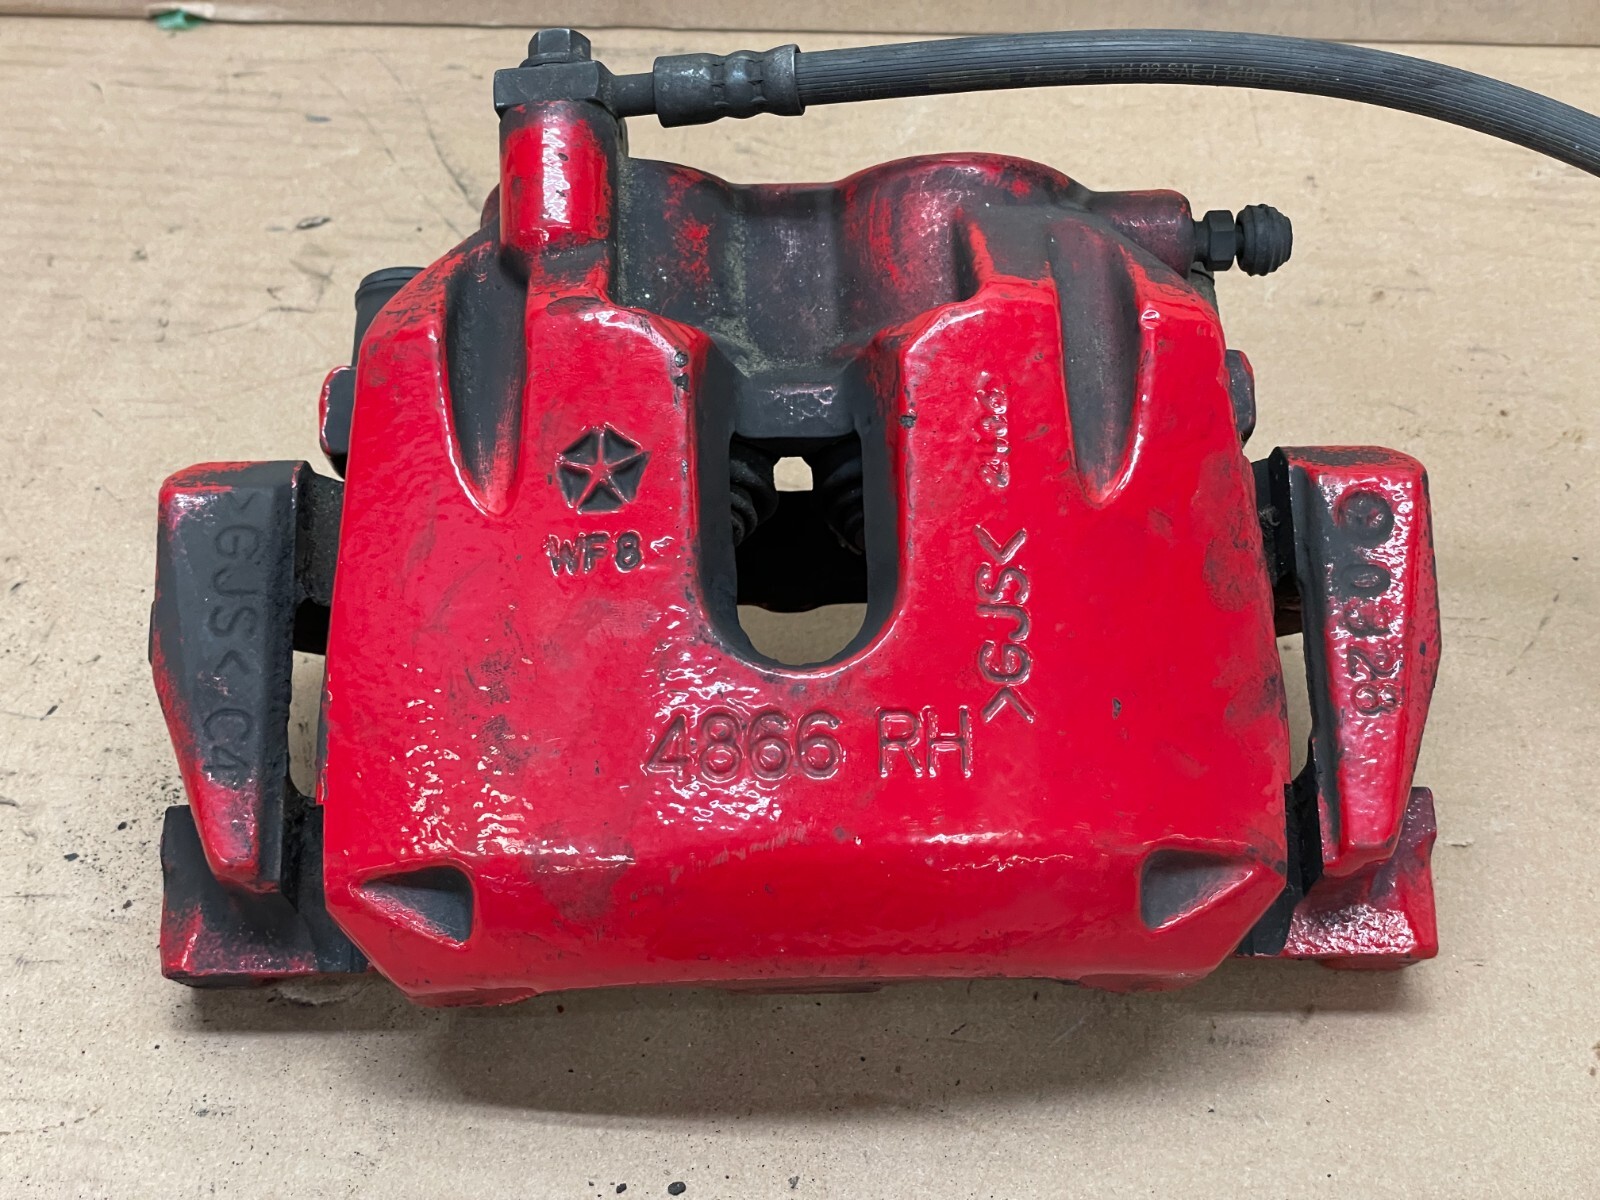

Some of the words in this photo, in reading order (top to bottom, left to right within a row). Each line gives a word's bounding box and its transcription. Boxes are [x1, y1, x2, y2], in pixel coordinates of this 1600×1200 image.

[1167, 63, 1201, 80] SAE
[641, 704, 846, 782] 4866
[876, 705, 973, 779] RH
